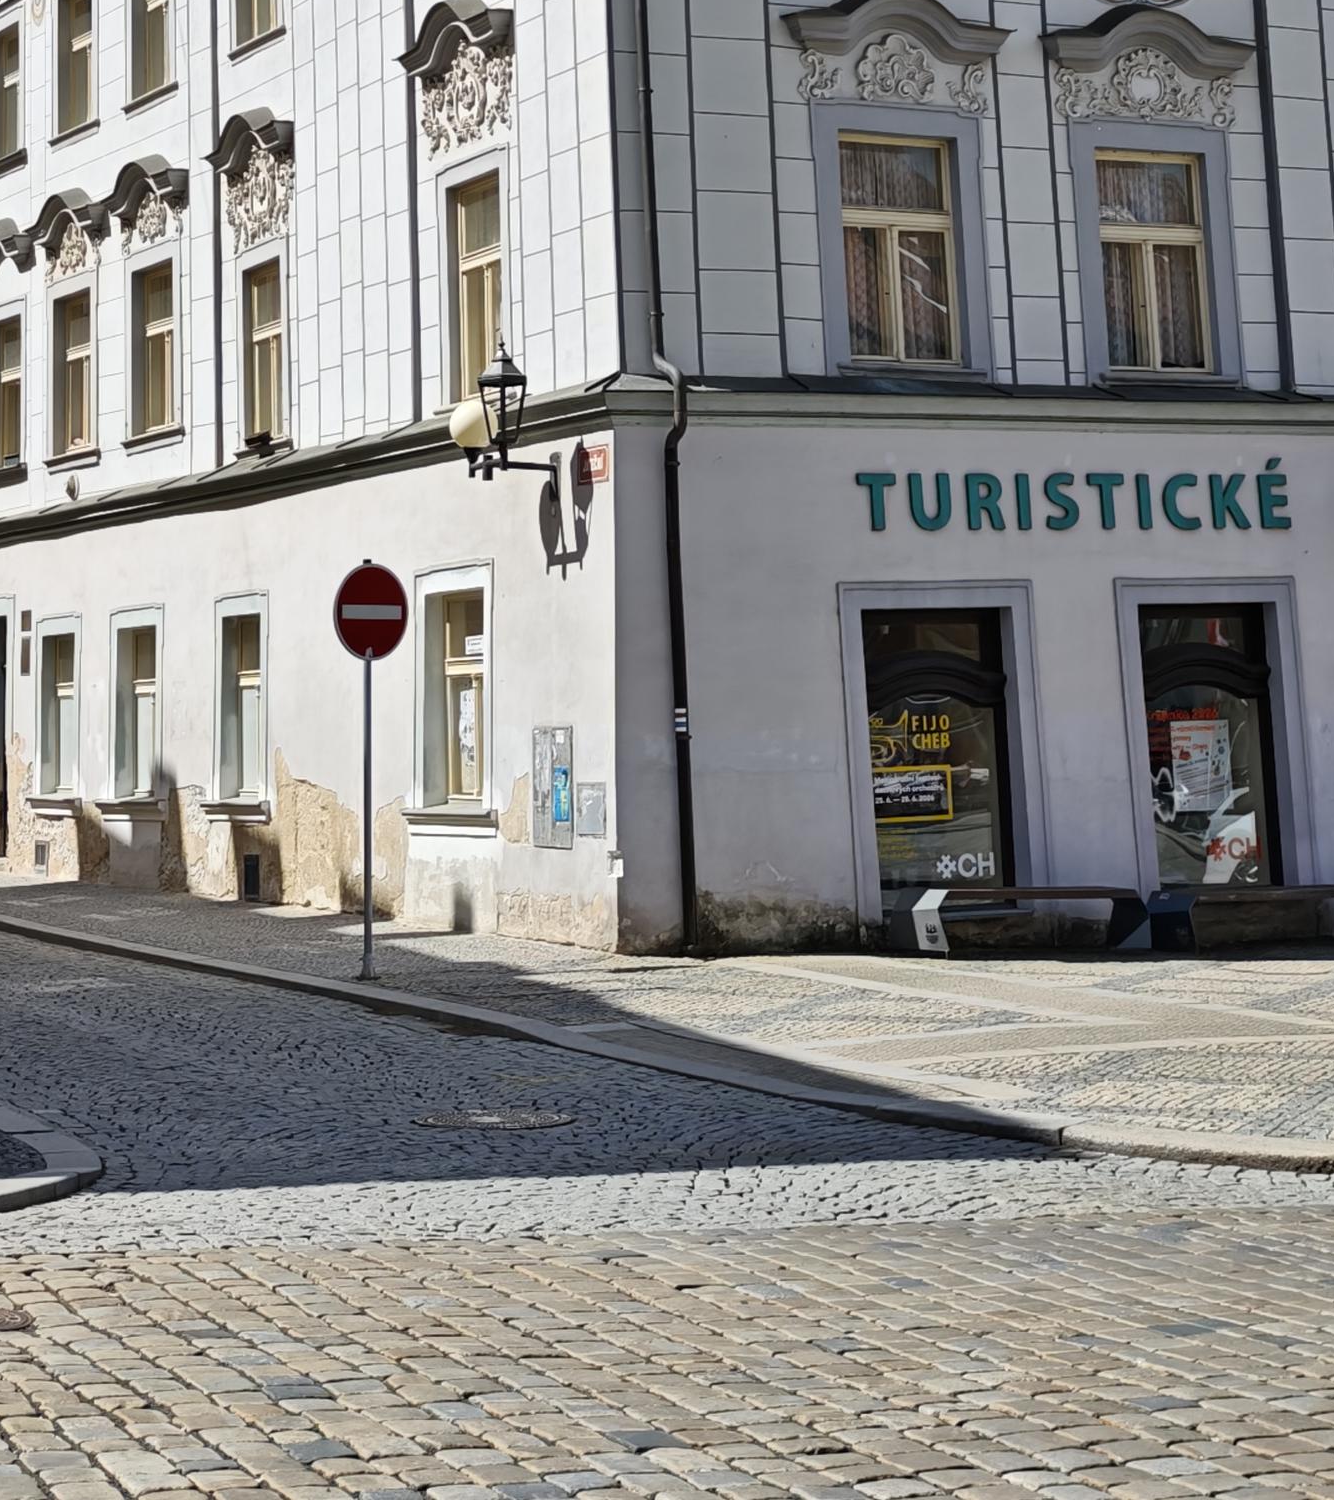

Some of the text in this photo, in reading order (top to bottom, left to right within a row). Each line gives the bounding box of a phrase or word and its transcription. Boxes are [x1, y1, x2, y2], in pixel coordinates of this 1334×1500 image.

[856, 457, 1292, 531] TURISTICKÉ
[911, 713, 951, 732] FIJO
[911, 731, 952, 750] CHEB
[957, 851, 996, 878] CH
